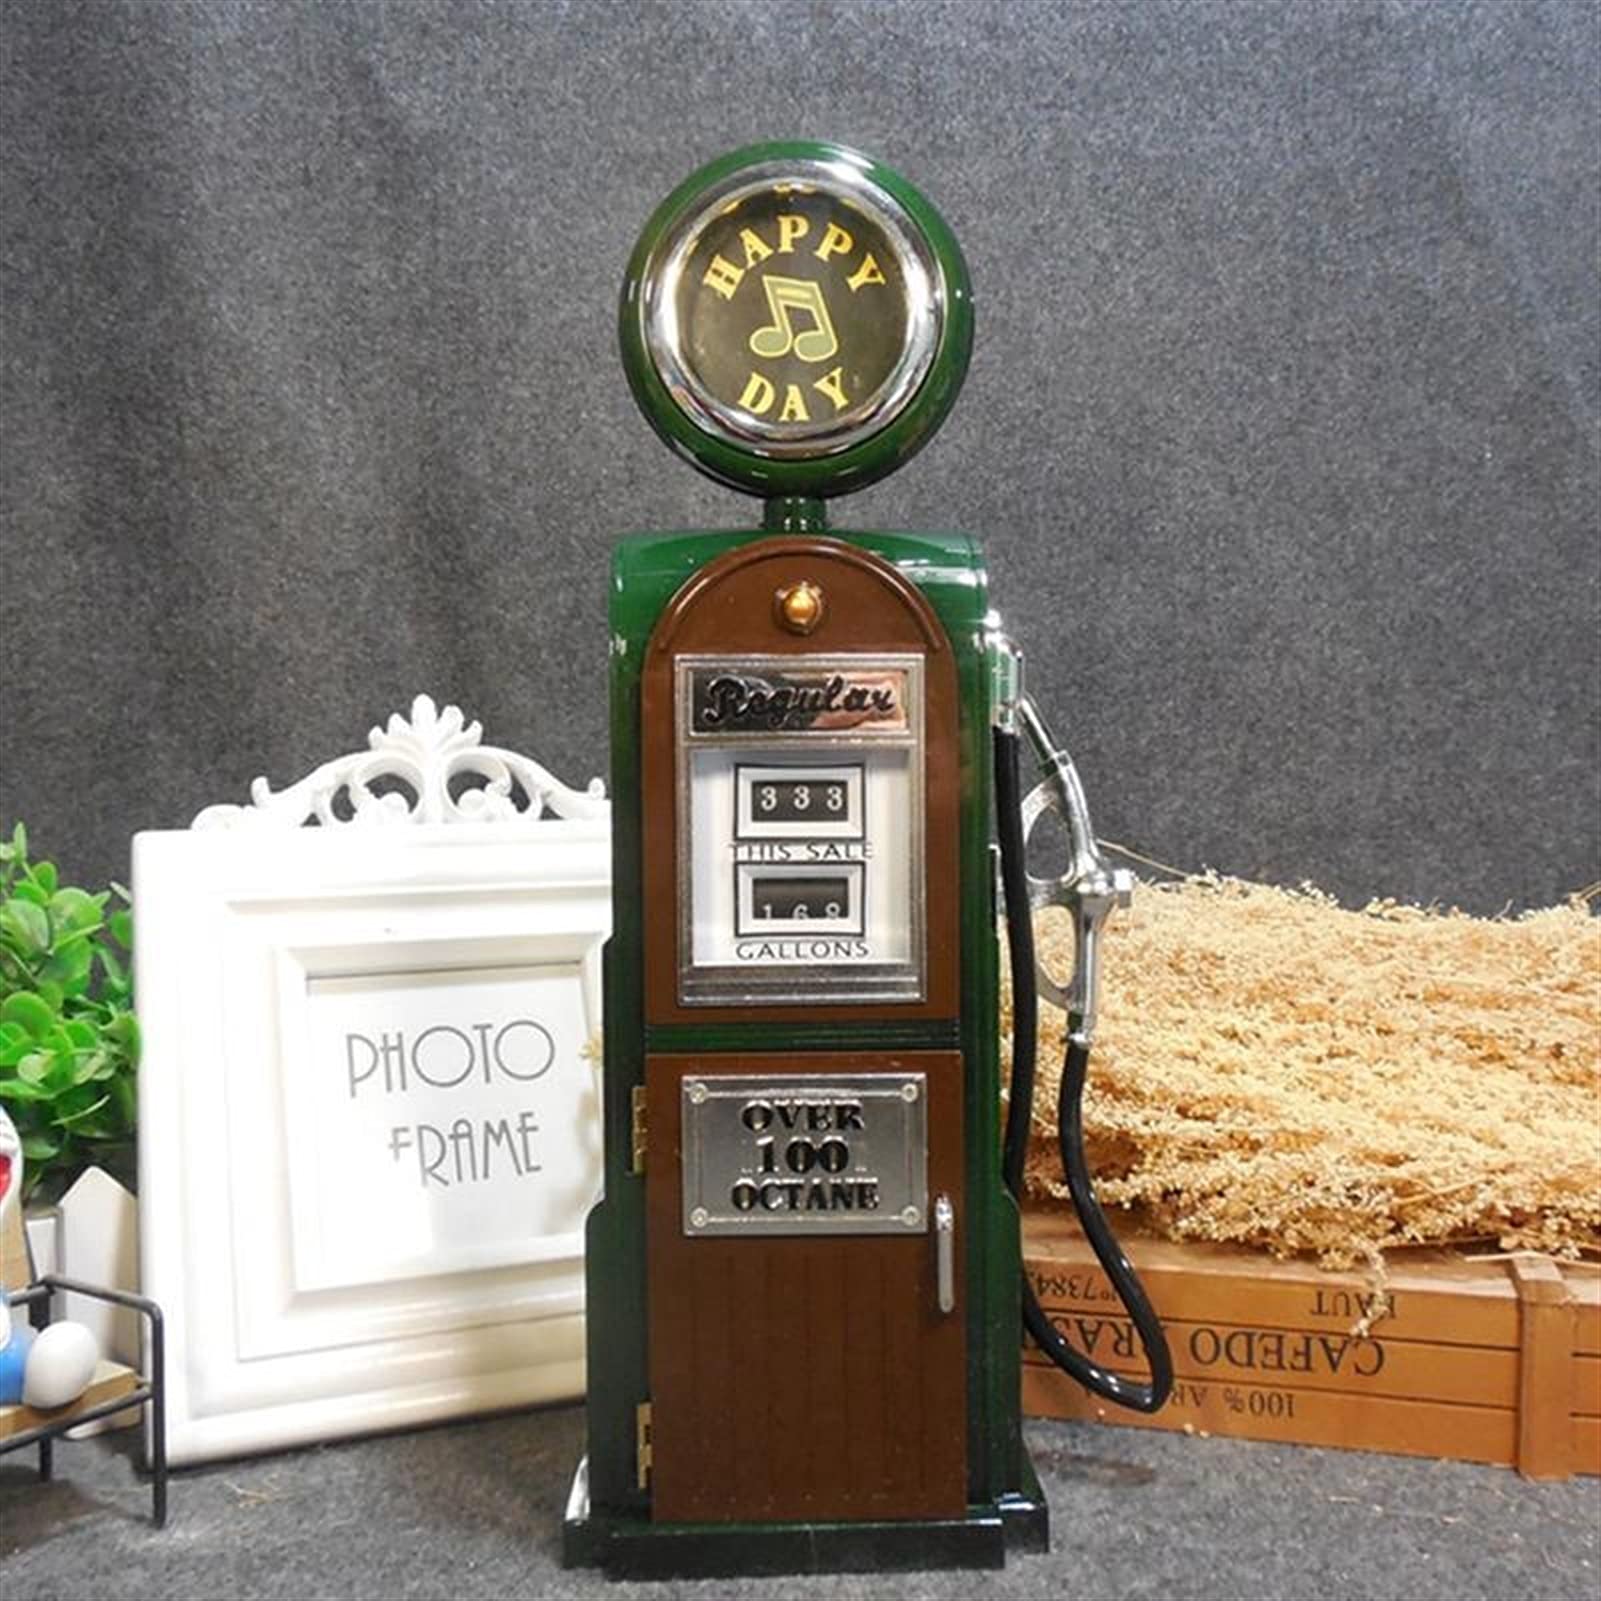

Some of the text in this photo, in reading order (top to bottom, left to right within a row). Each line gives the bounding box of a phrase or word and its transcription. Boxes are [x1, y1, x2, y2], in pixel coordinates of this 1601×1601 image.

[703, 215, 886, 300] HAPPY
[738, 366, 849, 422] DAY
[703, 676, 896, 726] Regular
[728, 841, 873, 860] THIS SALE
[736, 940, 869, 961] GALLONS
[346, 1019, 555, 1098] PHOTO
[741, 1099, 865, 1131] OVER
[389, 1112, 542, 1187] FRAME
[756, 1136, 849, 1174] 100
[731, 1177, 880, 1211] OCTANE
